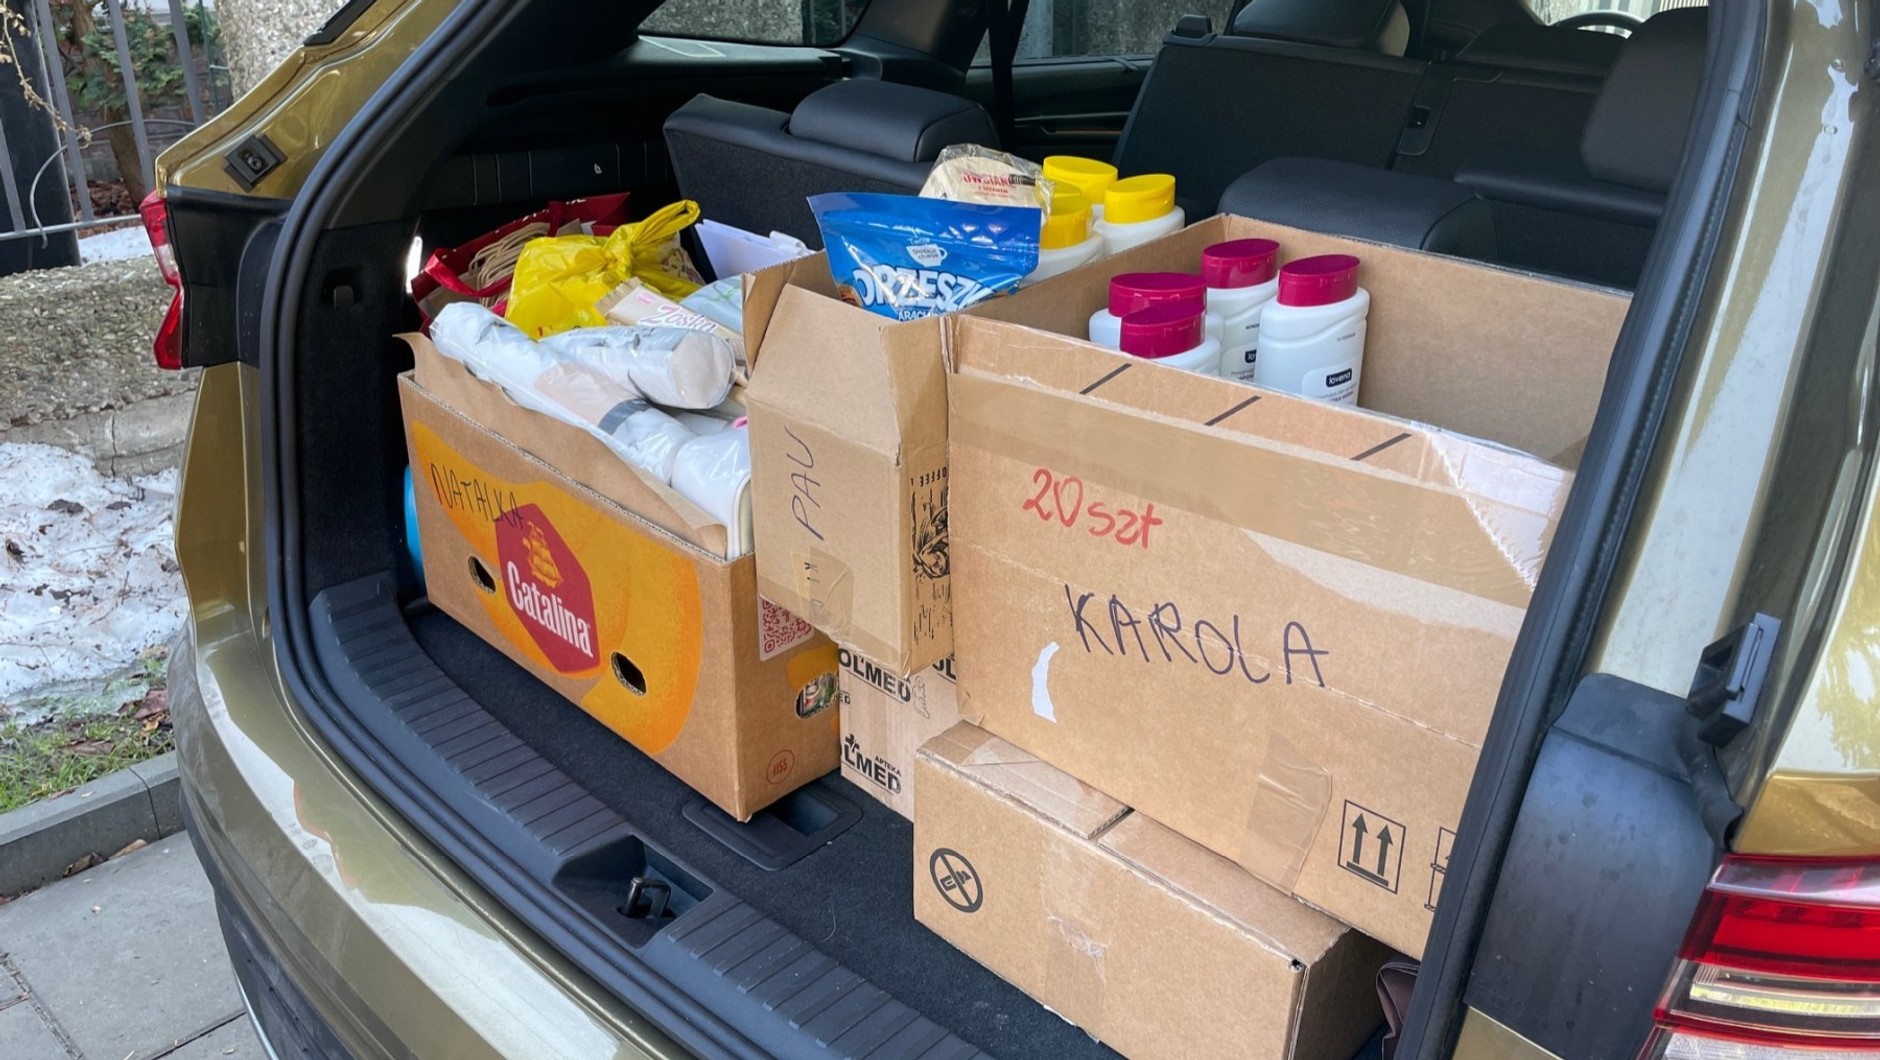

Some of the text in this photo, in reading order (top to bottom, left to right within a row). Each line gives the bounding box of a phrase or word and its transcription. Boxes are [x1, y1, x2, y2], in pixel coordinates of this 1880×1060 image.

[431, 463, 524, 531] NATALKA
[507, 560, 594, 658] Catalina
[1064, 583, 1330, 688] KAROLA
[844, 743, 902, 795] LMED
